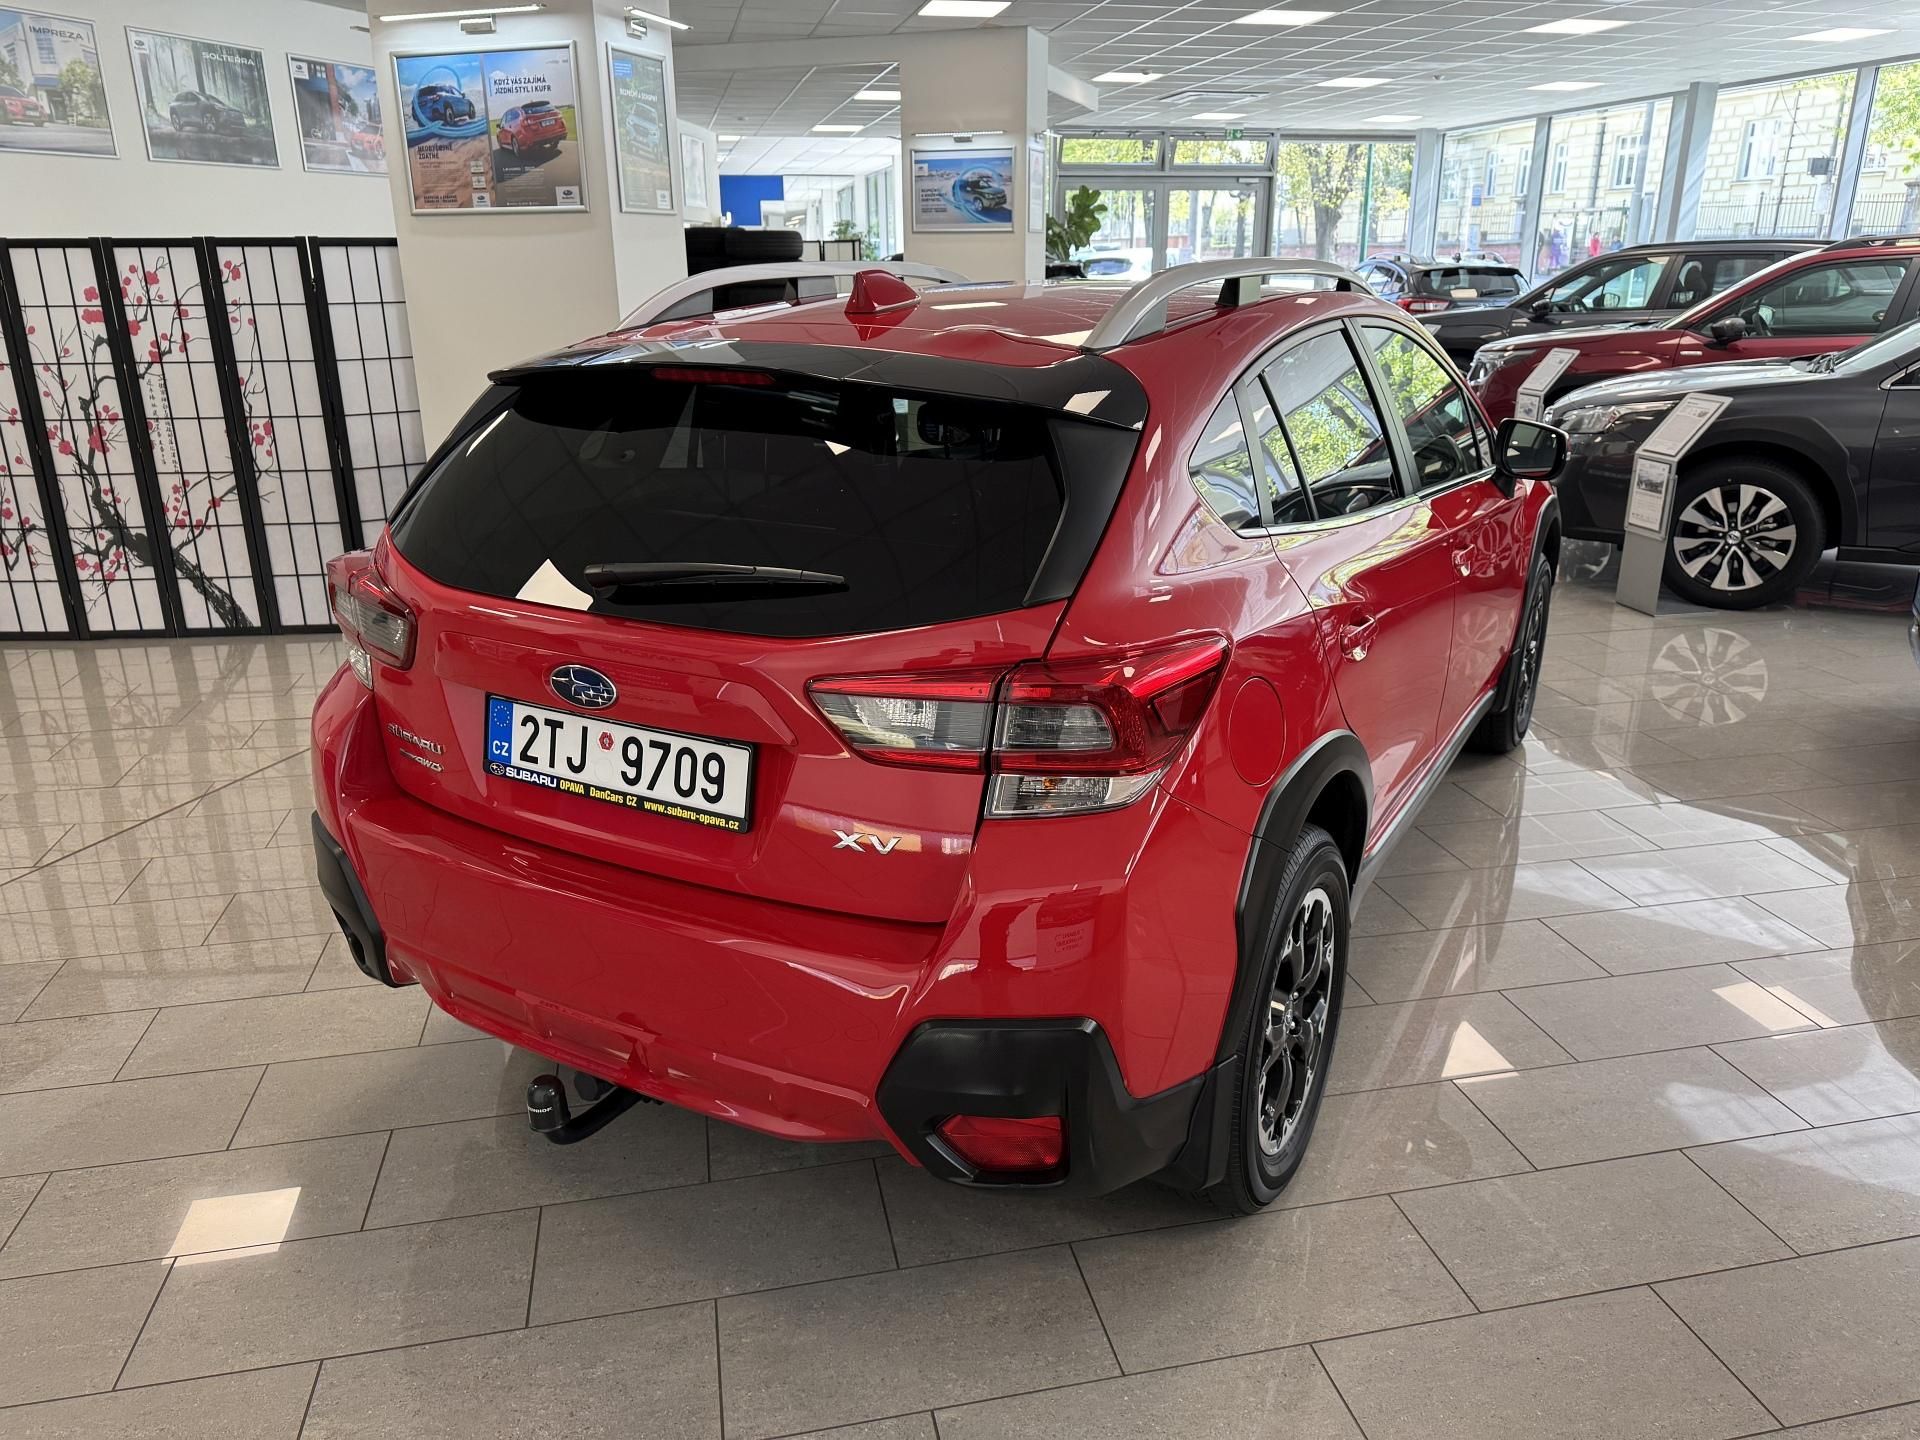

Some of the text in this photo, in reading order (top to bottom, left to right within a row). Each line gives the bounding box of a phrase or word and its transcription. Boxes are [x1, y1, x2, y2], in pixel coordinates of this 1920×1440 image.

[28, 25, 84, 40] IMPREZA
[202, 51, 255, 66] SOLTERRA
[492, 740, 509, 757] CZ
[520, 715, 726, 805] 2TJ 9709
[505, 766, 740, 830] SUBARU OPAVA DanCars CZ www.subaru-opava.cz
[832, 829, 902, 855] XV
